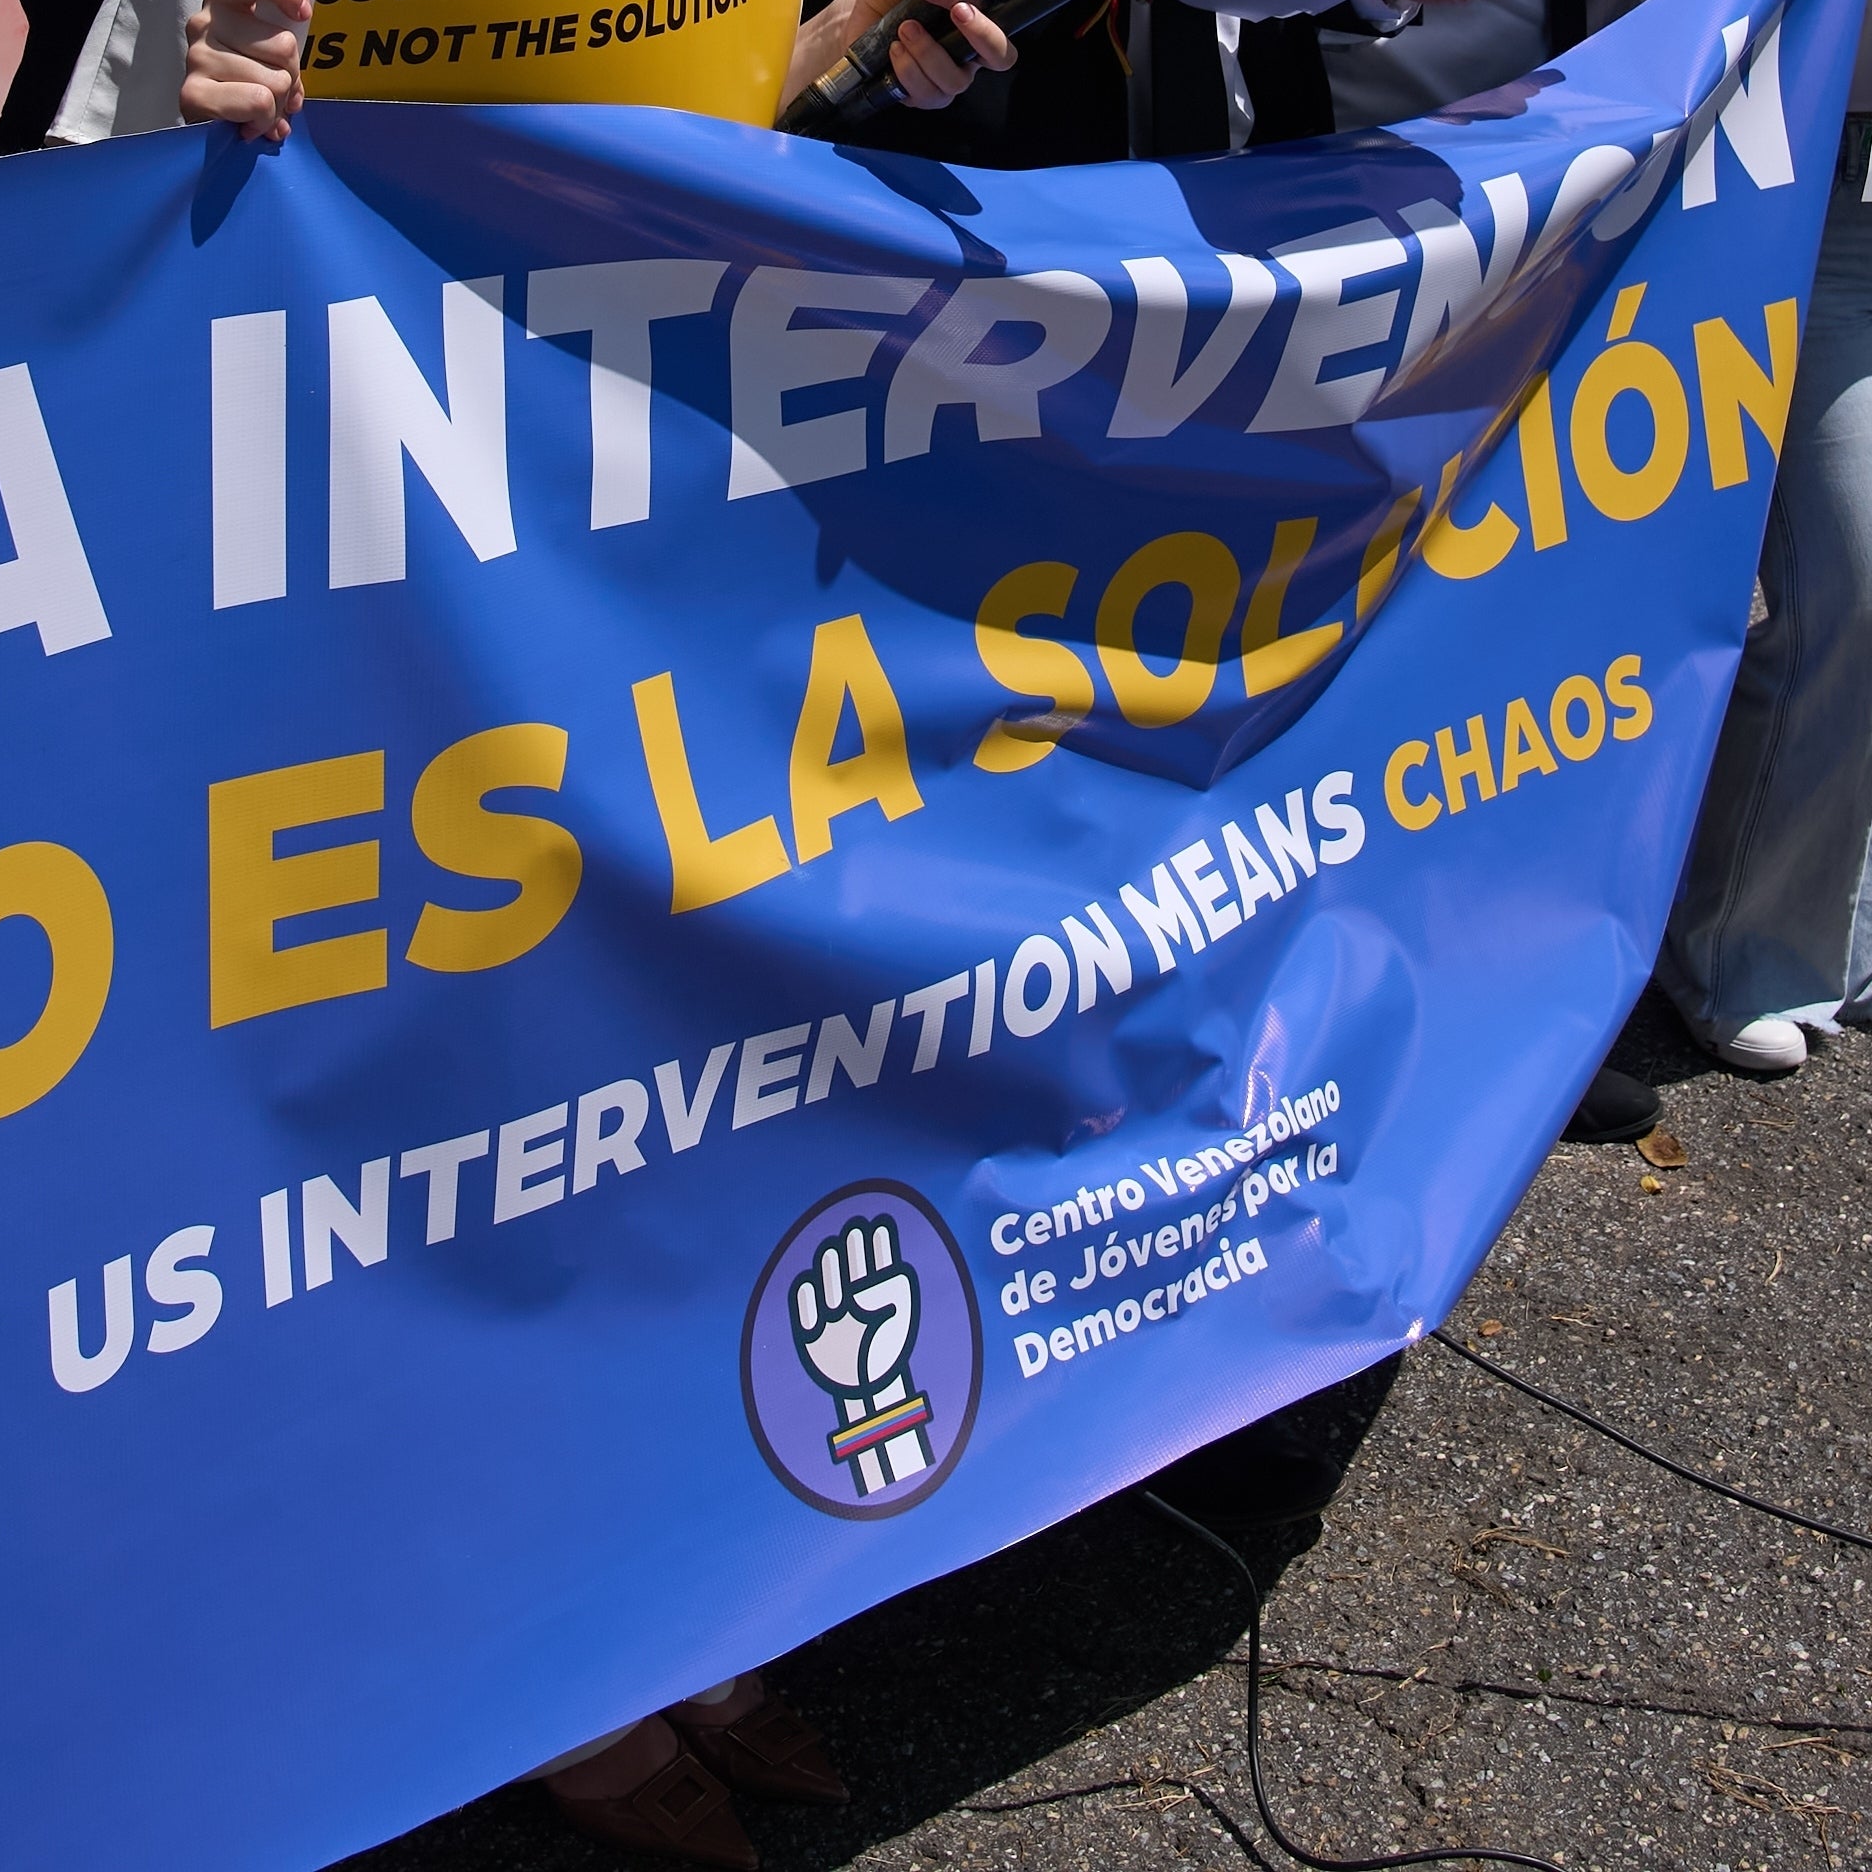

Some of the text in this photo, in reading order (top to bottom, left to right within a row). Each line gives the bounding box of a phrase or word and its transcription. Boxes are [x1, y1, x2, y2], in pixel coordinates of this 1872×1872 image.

[301, 33, 346, 71] IS
[359, 24, 476, 67] NOT
[487, 12, 577, 60] THE
[208, 722, 585, 1032] ES
[630, 613, 924, 915] LA
[47, 654, 1654, 1395] US INTERVENTION MEANS CHAOS
[990, 1080, 1341, 1256] Centro Venezolano
[1000, 1141, 1338, 1316] de Jóvenes por la
[1013, 1237, 1268, 1379] Democracia
